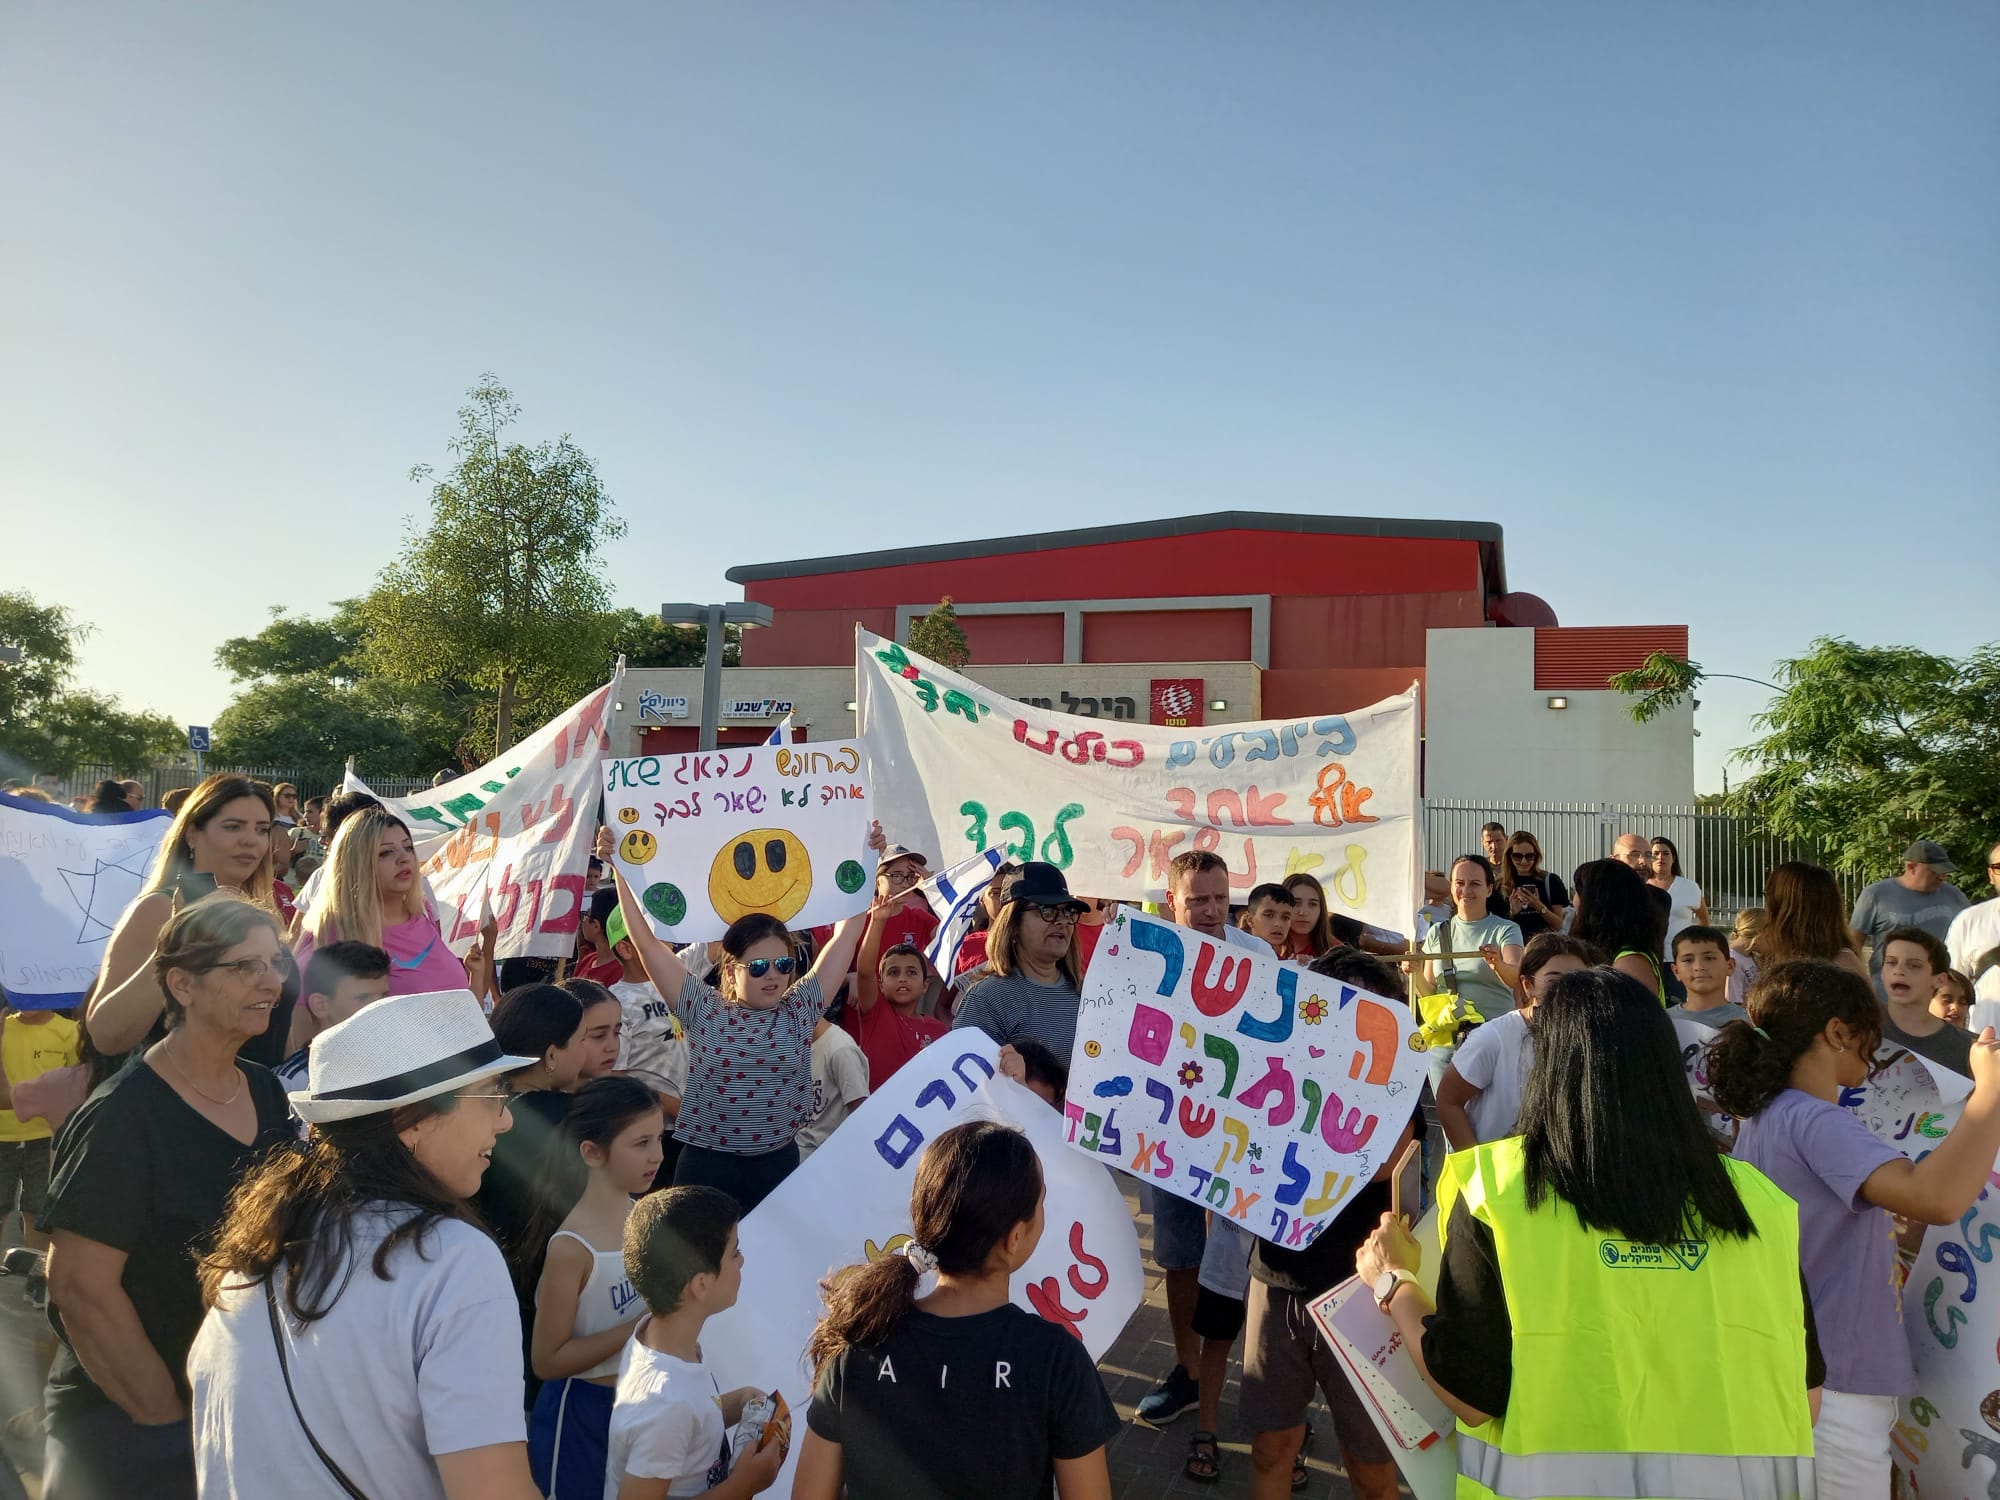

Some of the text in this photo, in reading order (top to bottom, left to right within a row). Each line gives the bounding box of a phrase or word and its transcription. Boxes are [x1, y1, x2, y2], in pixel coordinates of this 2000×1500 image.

[734, 701, 761, 713] שבע
[911, 679, 990, 723] יחד
[1061, 691, 1135, 719] היכל
[776, 747, 860, 777] בחופש
[1013, 719, 1144, 768] כולנו
[607, 756, 660, 791] שאף
[1166, 762, 1380, 828] אף אחד
[654, 783, 865, 827] אחד לא ישאר לבד
[960, 800, 1085, 871] לבד
[1130, 918, 1298, 1043] נשר
[1127, 1002, 1379, 1155] שומרים
[875, 1053, 995, 1170] חרם
[1145, 1077, 1355, 1217] על קשר
[1065, 1098, 1316, 1247] אף אחד לא לבד
[1620, 1254, 1663, 1265] וכימיקלים
[1679, 1244, 1699, 1256] פז
[877, 1354, 1013, 1389] AIR
